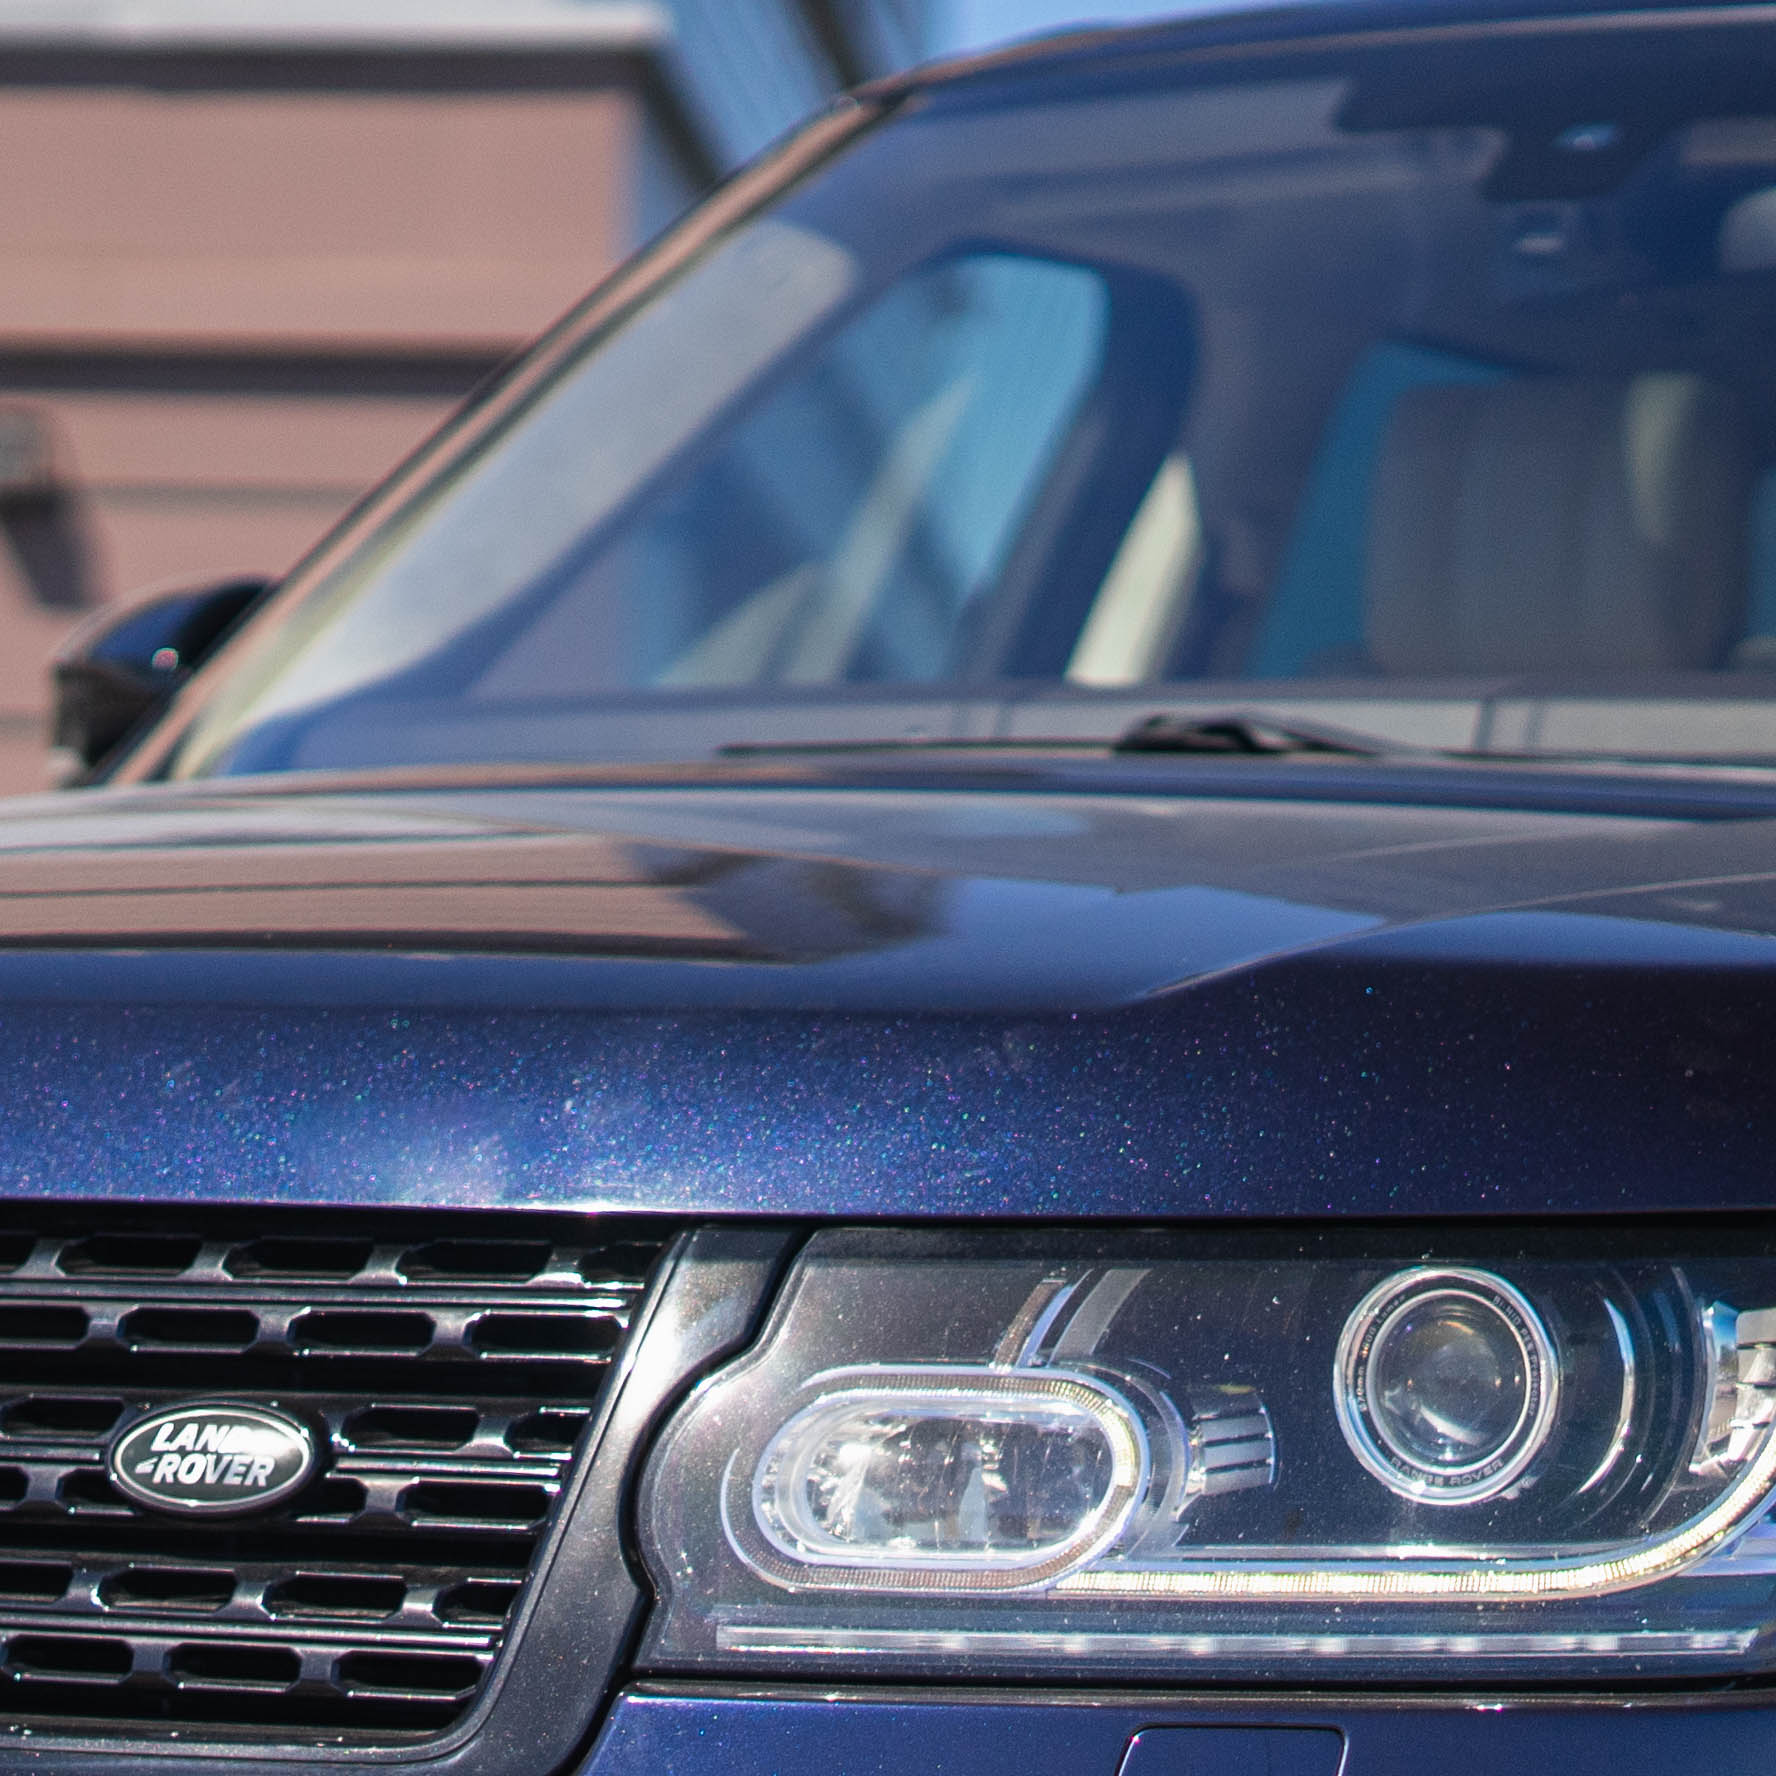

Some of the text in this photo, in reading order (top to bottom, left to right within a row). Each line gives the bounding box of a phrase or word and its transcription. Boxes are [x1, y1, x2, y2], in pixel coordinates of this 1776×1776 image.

[151, 1452, 275, 1487] ROVER
[1390, 1457, 1504, 1486] RANGE ROVER
